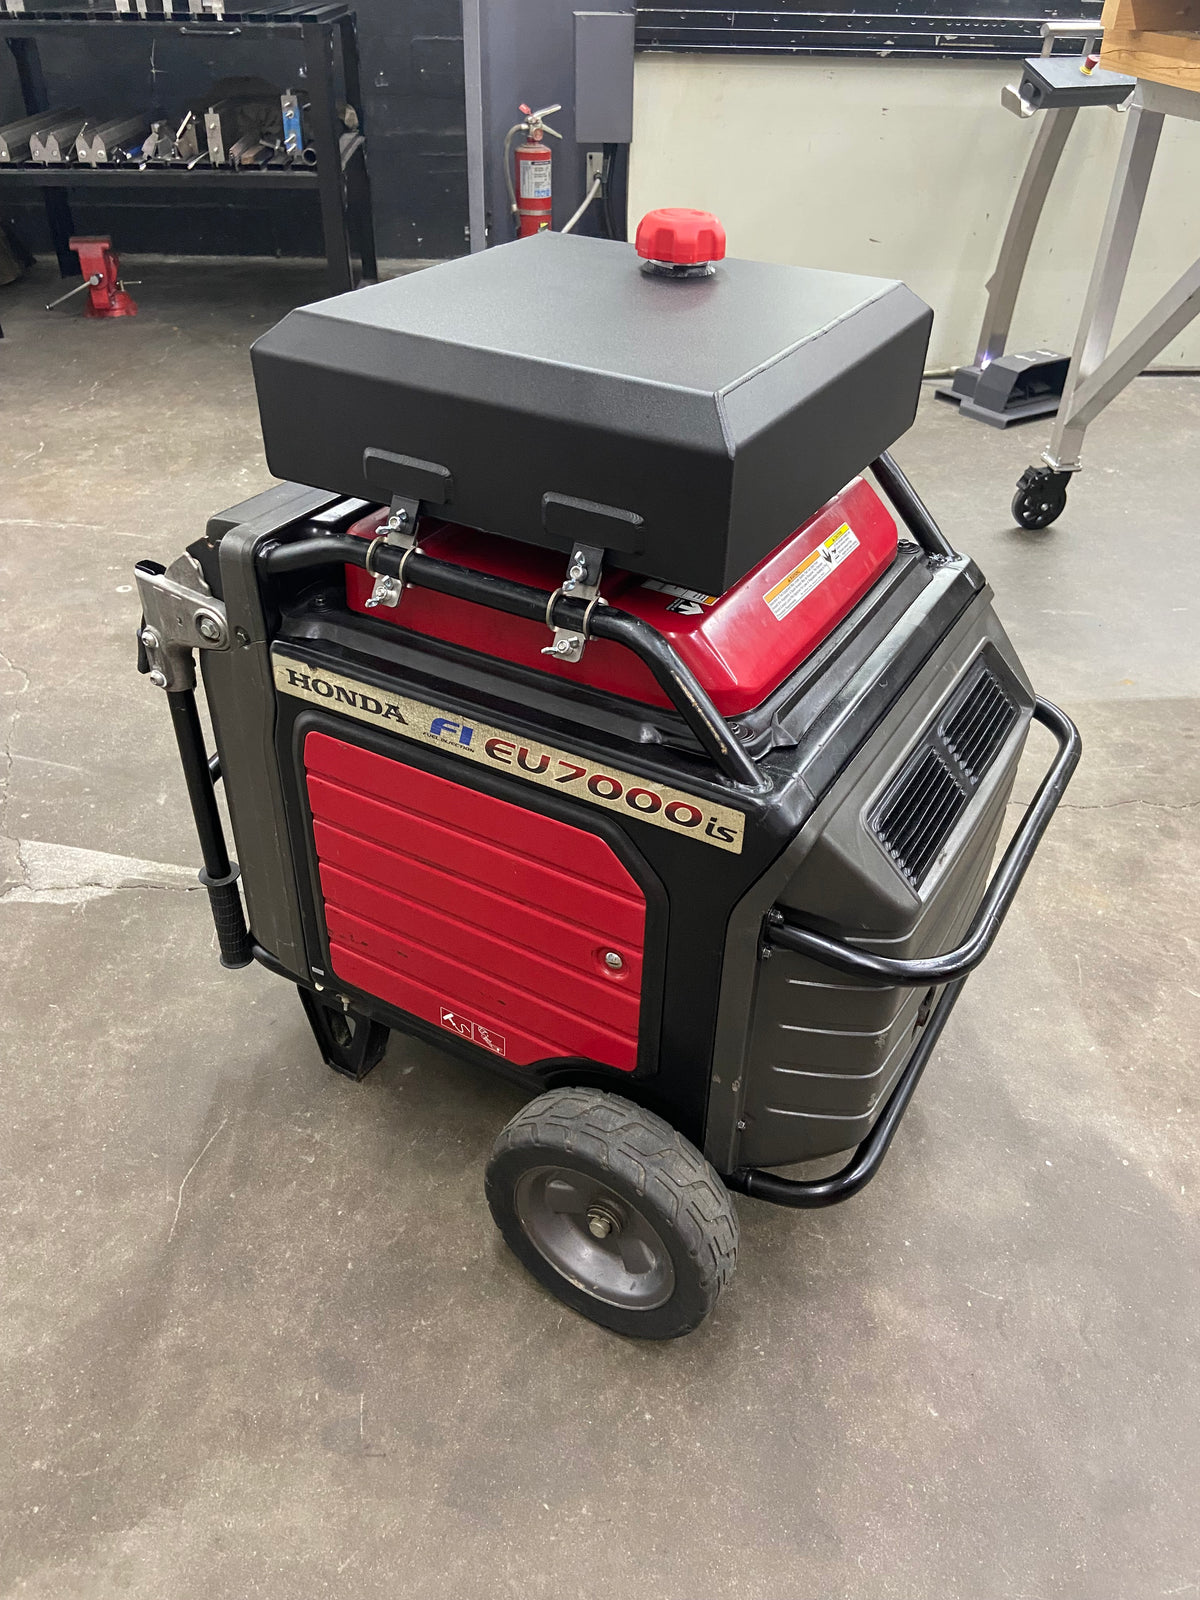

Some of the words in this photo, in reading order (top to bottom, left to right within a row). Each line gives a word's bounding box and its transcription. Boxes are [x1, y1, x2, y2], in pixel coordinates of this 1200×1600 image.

[286, 668, 408, 725] HONDA
[430, 717, 473, 746] FI
[484, 738, 738, 843] EU7000is
[423, 731, 439, 741] FUEL
[440, 738, 475, 753] INJECTION
